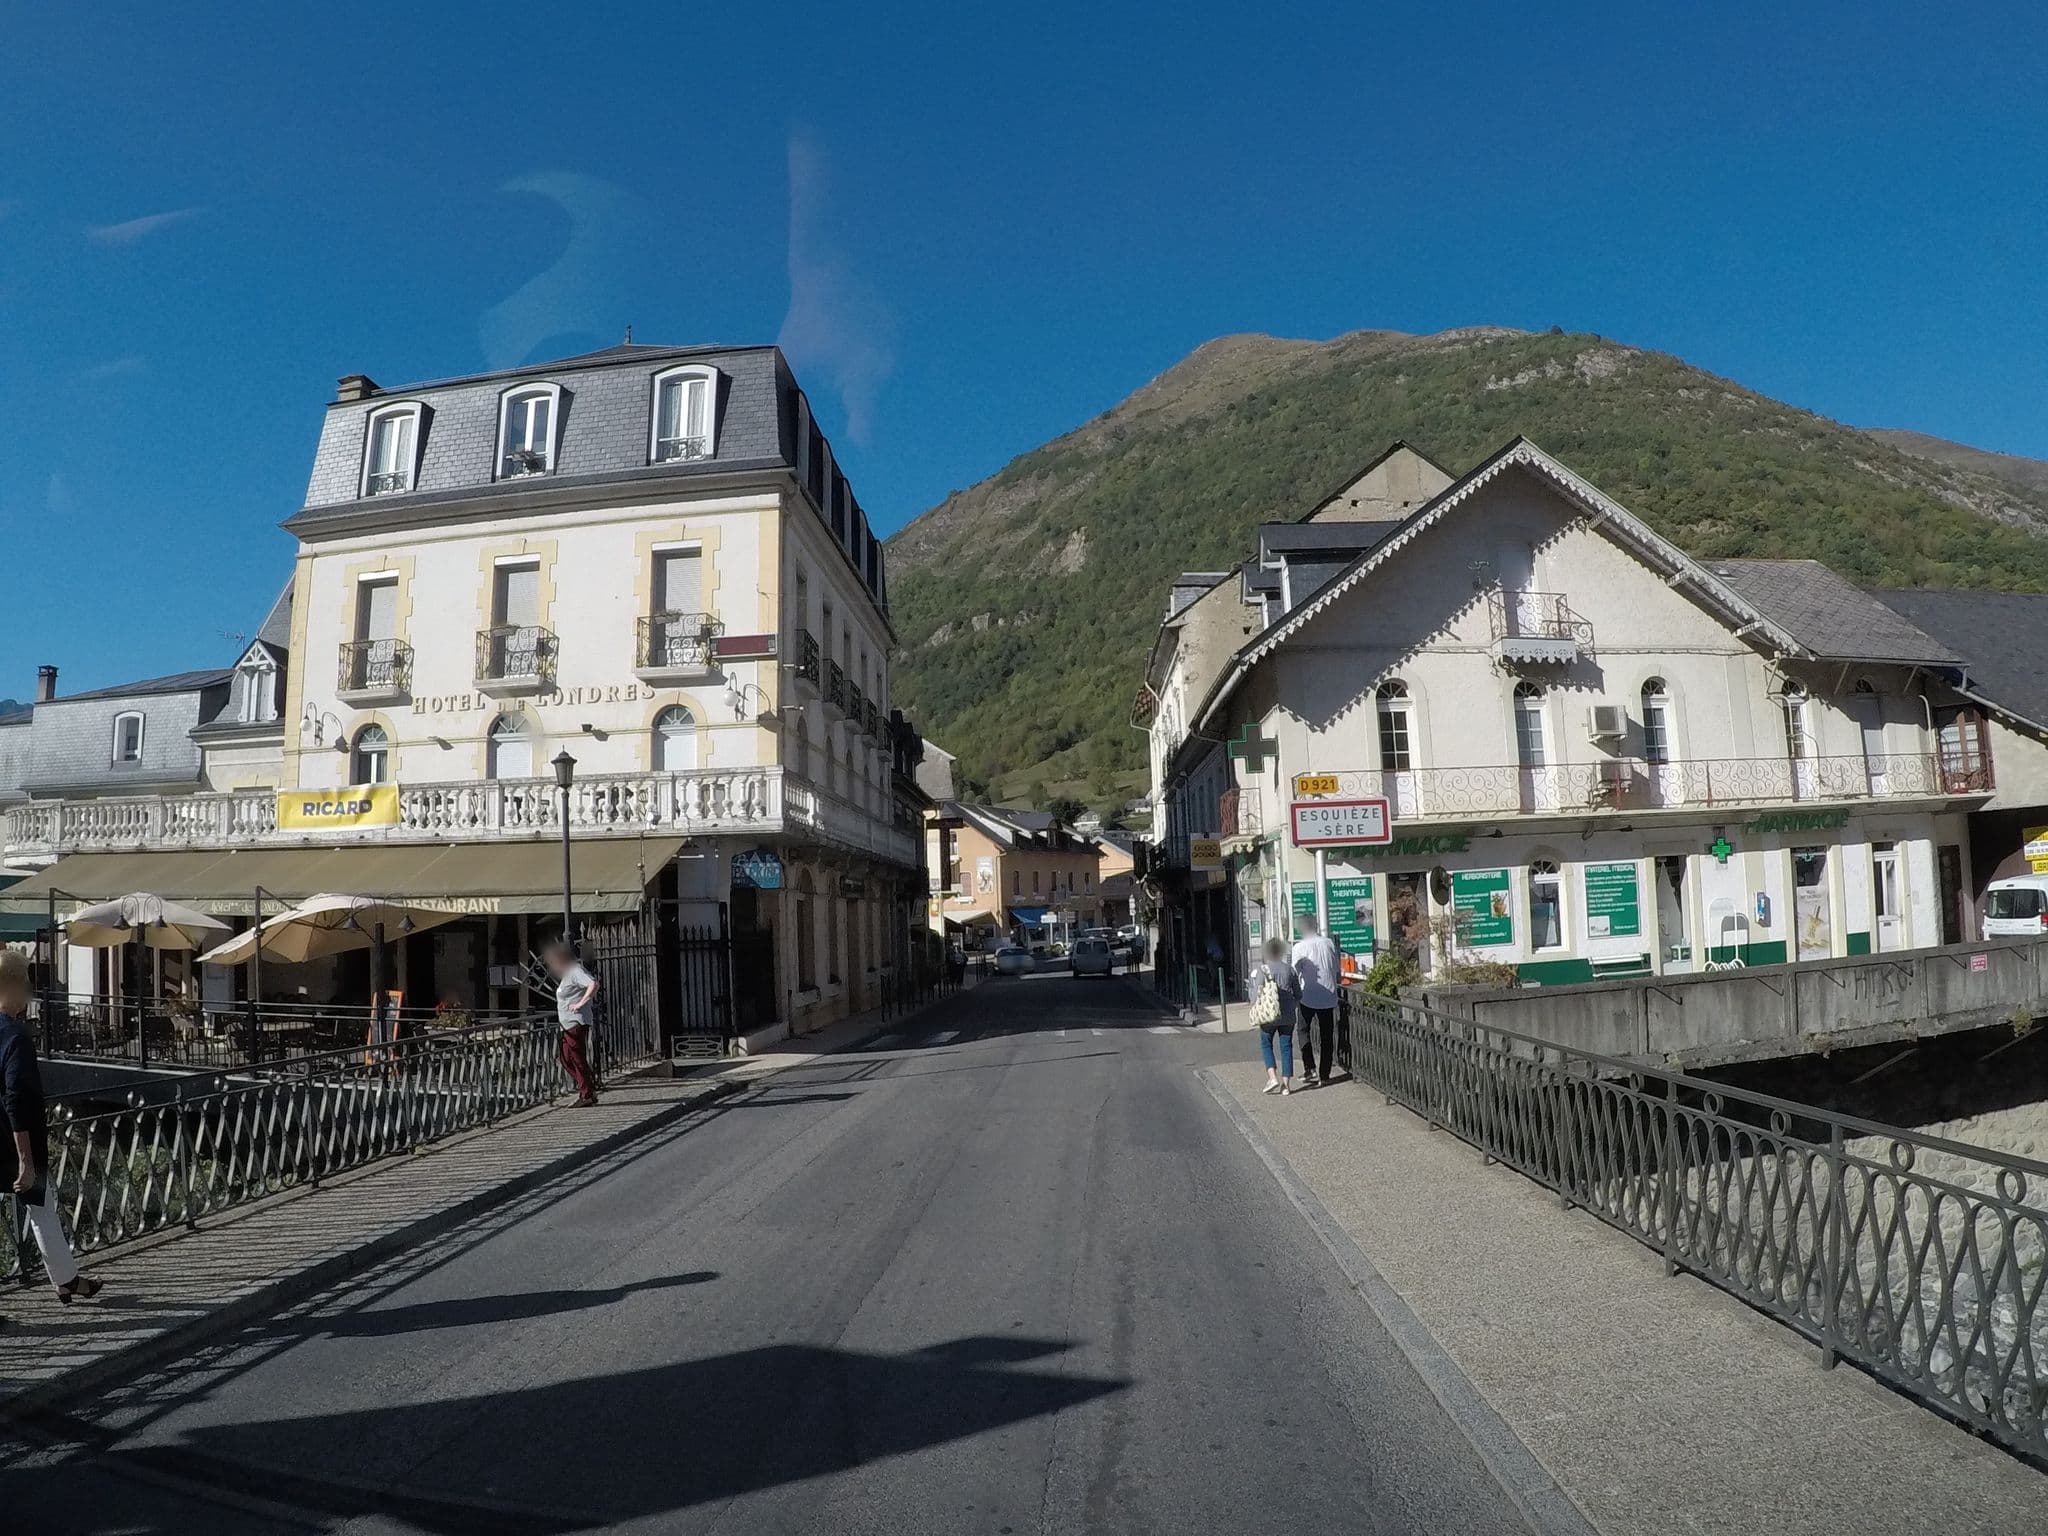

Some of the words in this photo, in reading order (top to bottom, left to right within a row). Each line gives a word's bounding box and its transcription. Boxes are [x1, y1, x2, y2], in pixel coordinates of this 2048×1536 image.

[412, 693, 486, 714] HOTEL
[535, 683, 656, 707] LONDRES
[1300, 780, 1309, 791] D
[1312, 779, 1335, 790] 921
[302, 800, 373, 817] RICARD
[1300, 807, 1380, 822] ESQUIÈZE
[1318, 823, 1365, 836] -SÈRE
[1331, 878, 1367, 888] PHARMACIE
[1332, 889, 1366, 898] THERMALE
